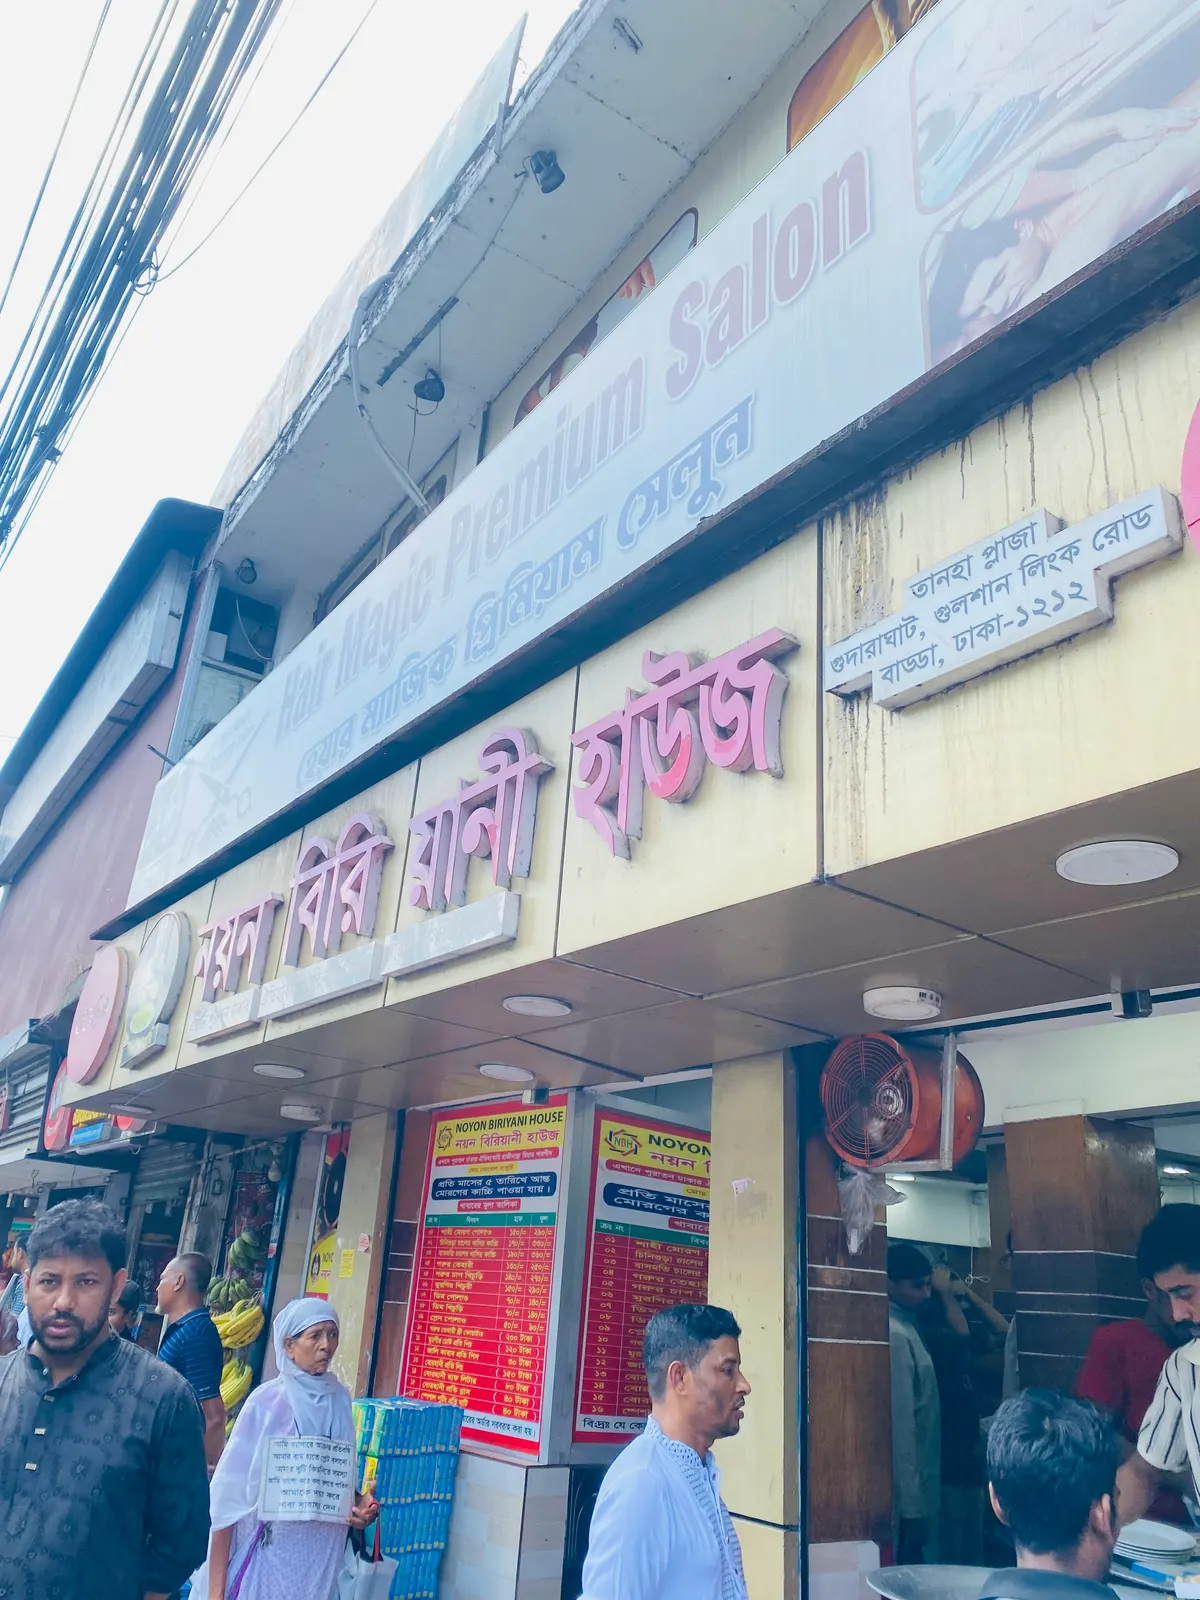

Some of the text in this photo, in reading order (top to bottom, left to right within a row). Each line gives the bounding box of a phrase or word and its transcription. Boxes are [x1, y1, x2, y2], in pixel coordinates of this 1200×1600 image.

[275, 146, 872, 747] Hair Magic Premium Salon
[910, 521, 1037, 598] তানহা প্লাজা
[296, 393, 756, 792] হেয়ার ম্যাজিক প্রিমিয়াম সেলুন
[830, 504, 1154, 674] গুদারাঘাট, গুলশান লিংক রোড
[879, 581, 1088, 684] বাড্ডা, ঢাকা-১২১২
[195, 892, 284, 1001] নয়ন
[571, 627, 799, 860] হাউজ
[455, 1111, 563, 1133] NOYON BIRIYANI HOUSE
[455, 1138, 476, 1150] নয়ন
[480, 1131, 522, 1148] বিরিয়ানী
[527, 1128, 560, 1144] হাউজ
[614, 1137, 633, 1150] NBH
[648, 1133, 711, 1157] NOYON
[649, 1151, 697, 1171] নয়ন
[436, 1188, 468, 1197] মোরগের
[497, 1185, 524, 1195] পাওয়া
[438, 1178, 455, 1188] প্রতি
[458, 1179, 482, 1187] মাসের
[496, 1175, 528, 1185] তারিখে
[618, 1187, 657, 1200] প্রতি
[613, 1196, 688, 1216] মোরগের
[613, 1421, 626, 1430] যে
